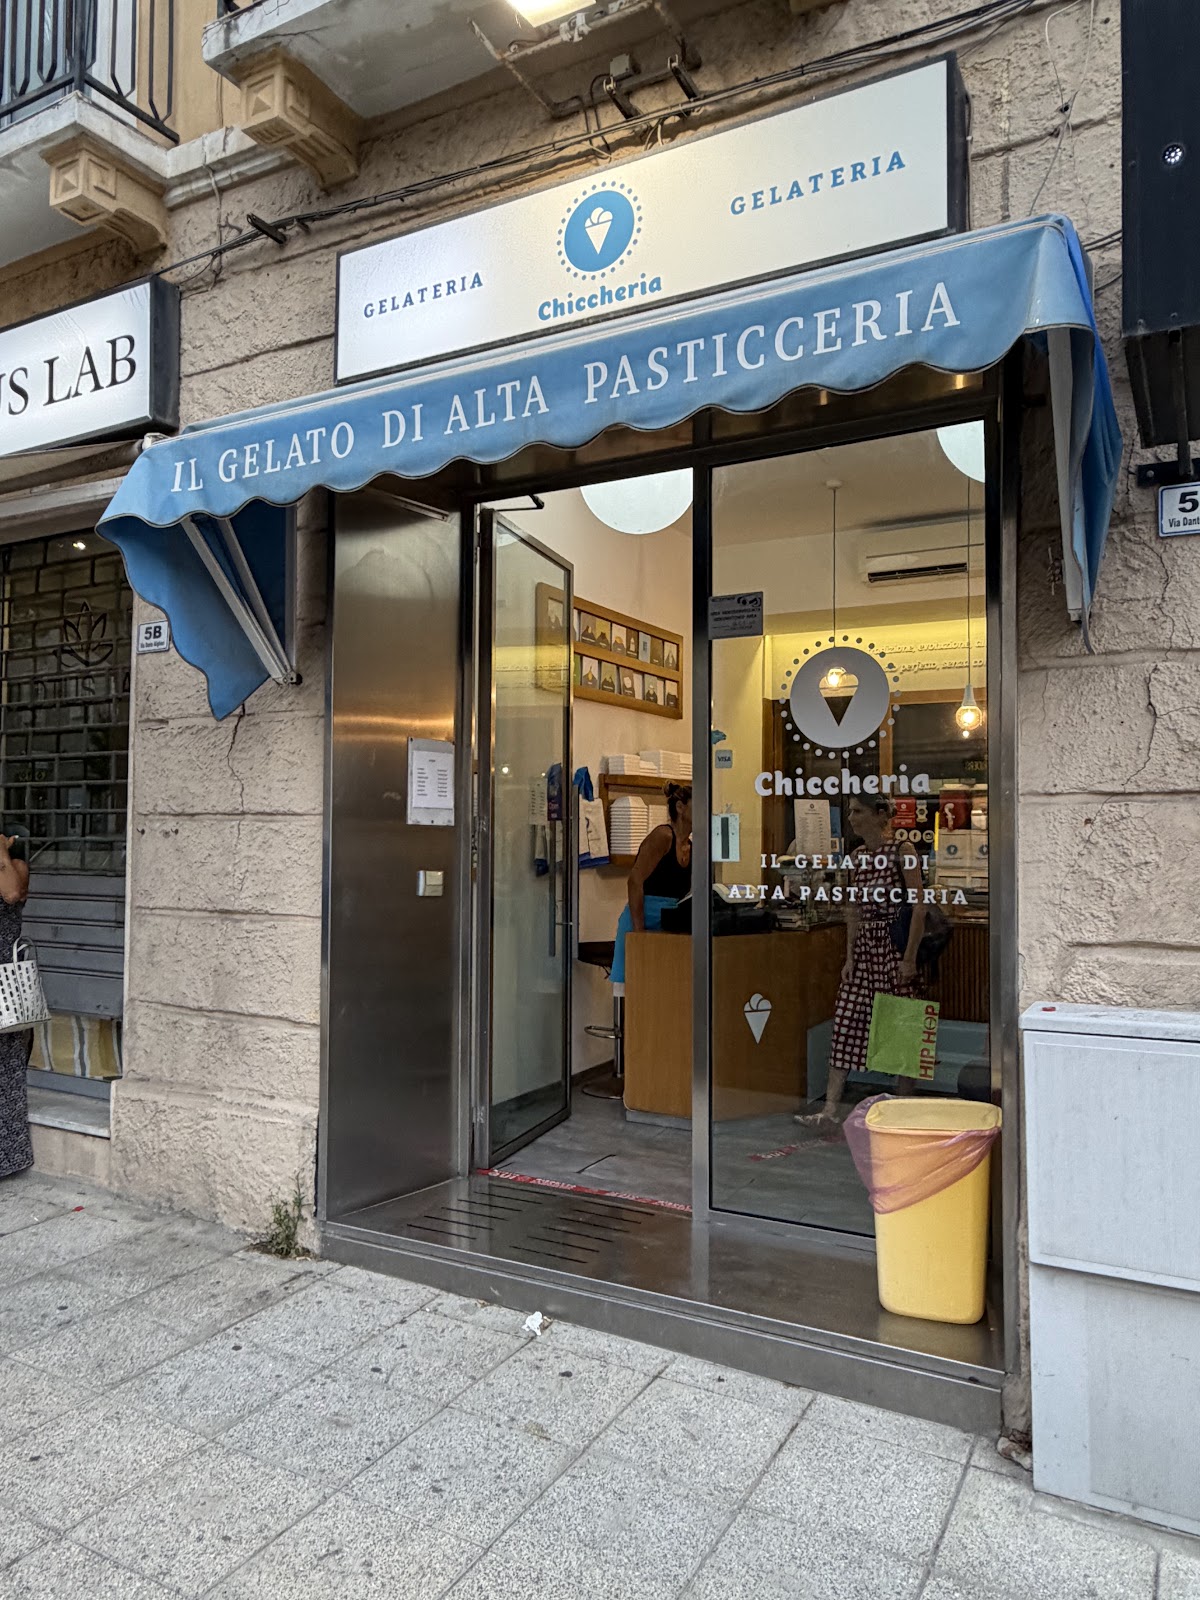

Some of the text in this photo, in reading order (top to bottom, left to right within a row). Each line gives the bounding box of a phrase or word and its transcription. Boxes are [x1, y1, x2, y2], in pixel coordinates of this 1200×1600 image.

[730, 150, 906, 216] GELATERIA
[363, 271, 484, 319] GELATERIA
[538, 272, 663, 322] Chiccheria
[43, 334, 137, 407] LAB
[170, 281, 961, 493] IL GELATO DI ALTA PASTICCERIA
[1177, 490, 1199, 513] 5
[1168, 517, 1181, 528] Via
[144, 625, 162, 640] 5B
[754, 763, 932, 797] Chiccheria
[760, 853, 930, 870] IL GELATO DI
[728, 884, 968, 905] ALTA PASTICCERIA
[919, 1047, 935, 1080] HIP
